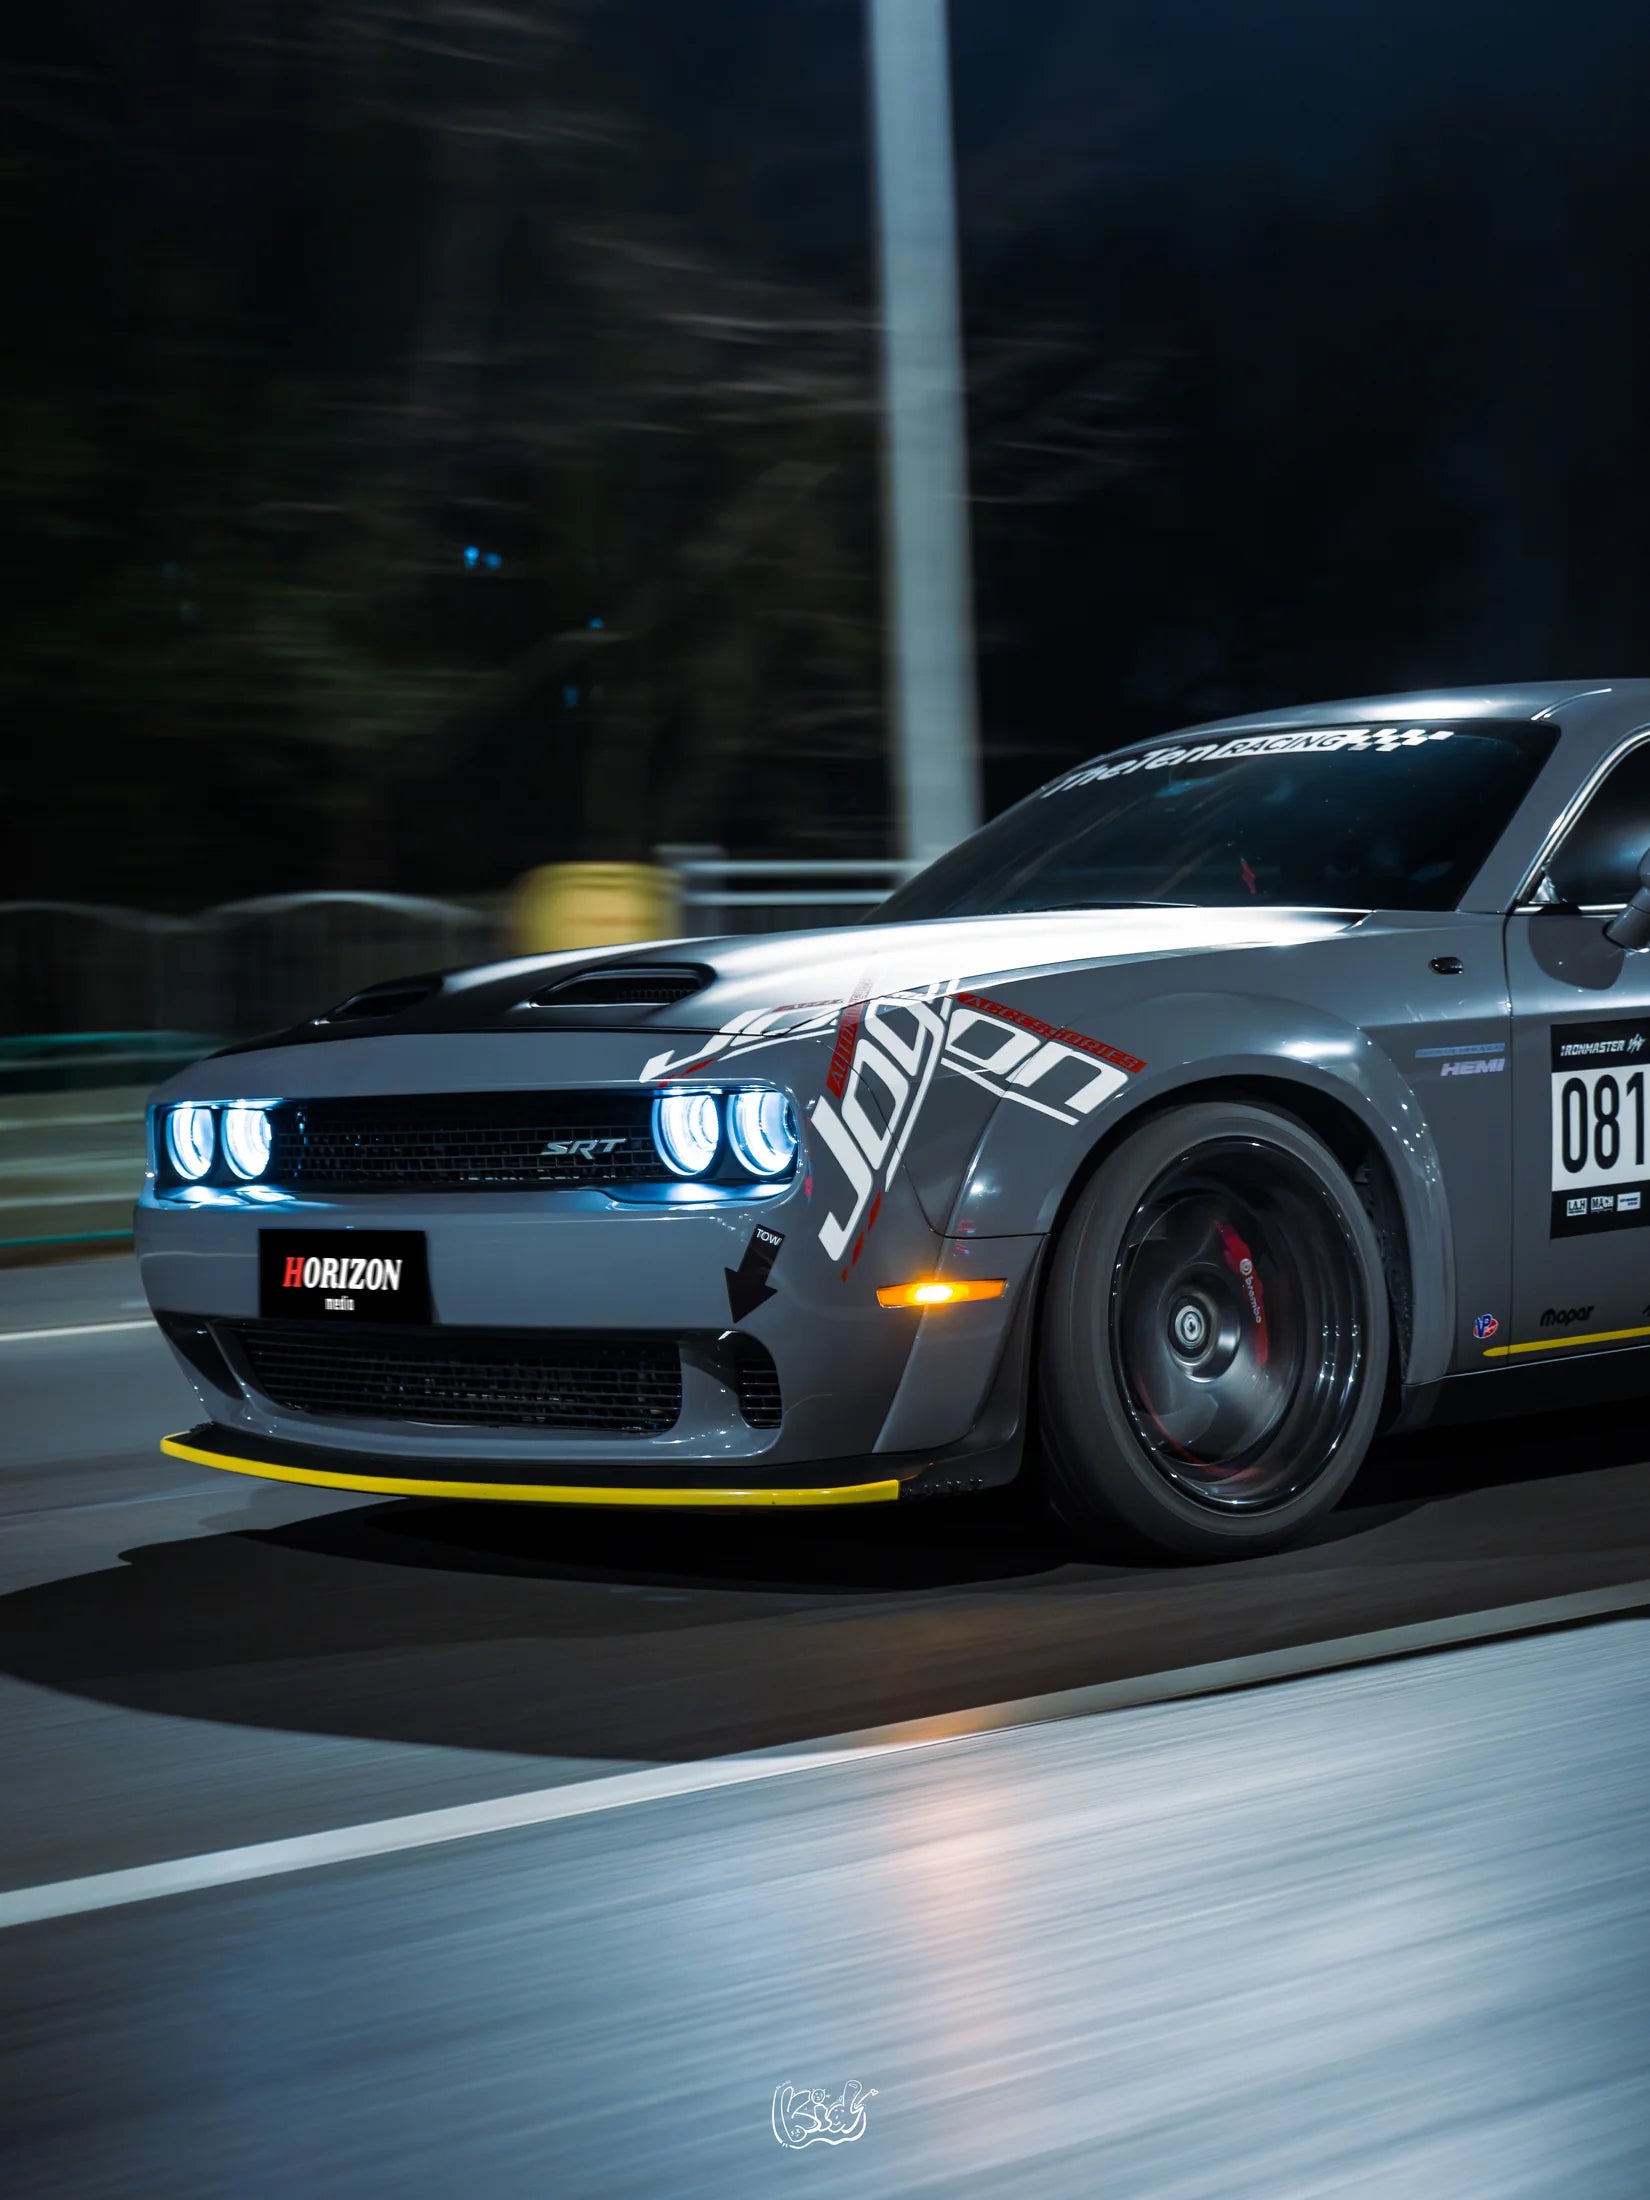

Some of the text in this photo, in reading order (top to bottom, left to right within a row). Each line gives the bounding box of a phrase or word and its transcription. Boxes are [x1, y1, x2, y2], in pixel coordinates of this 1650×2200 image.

[1560, 1040, 1625, 1057] IRONMASTER
[1440, 1058, 1505, 1077] HEMI
[1562, 1071, 1645, 1174] 081
[540, 1138, 627, 1160] SRT
[756, 1228, 783, 1246] TOW
[282, 1257, 403, 1291] HORIZON
